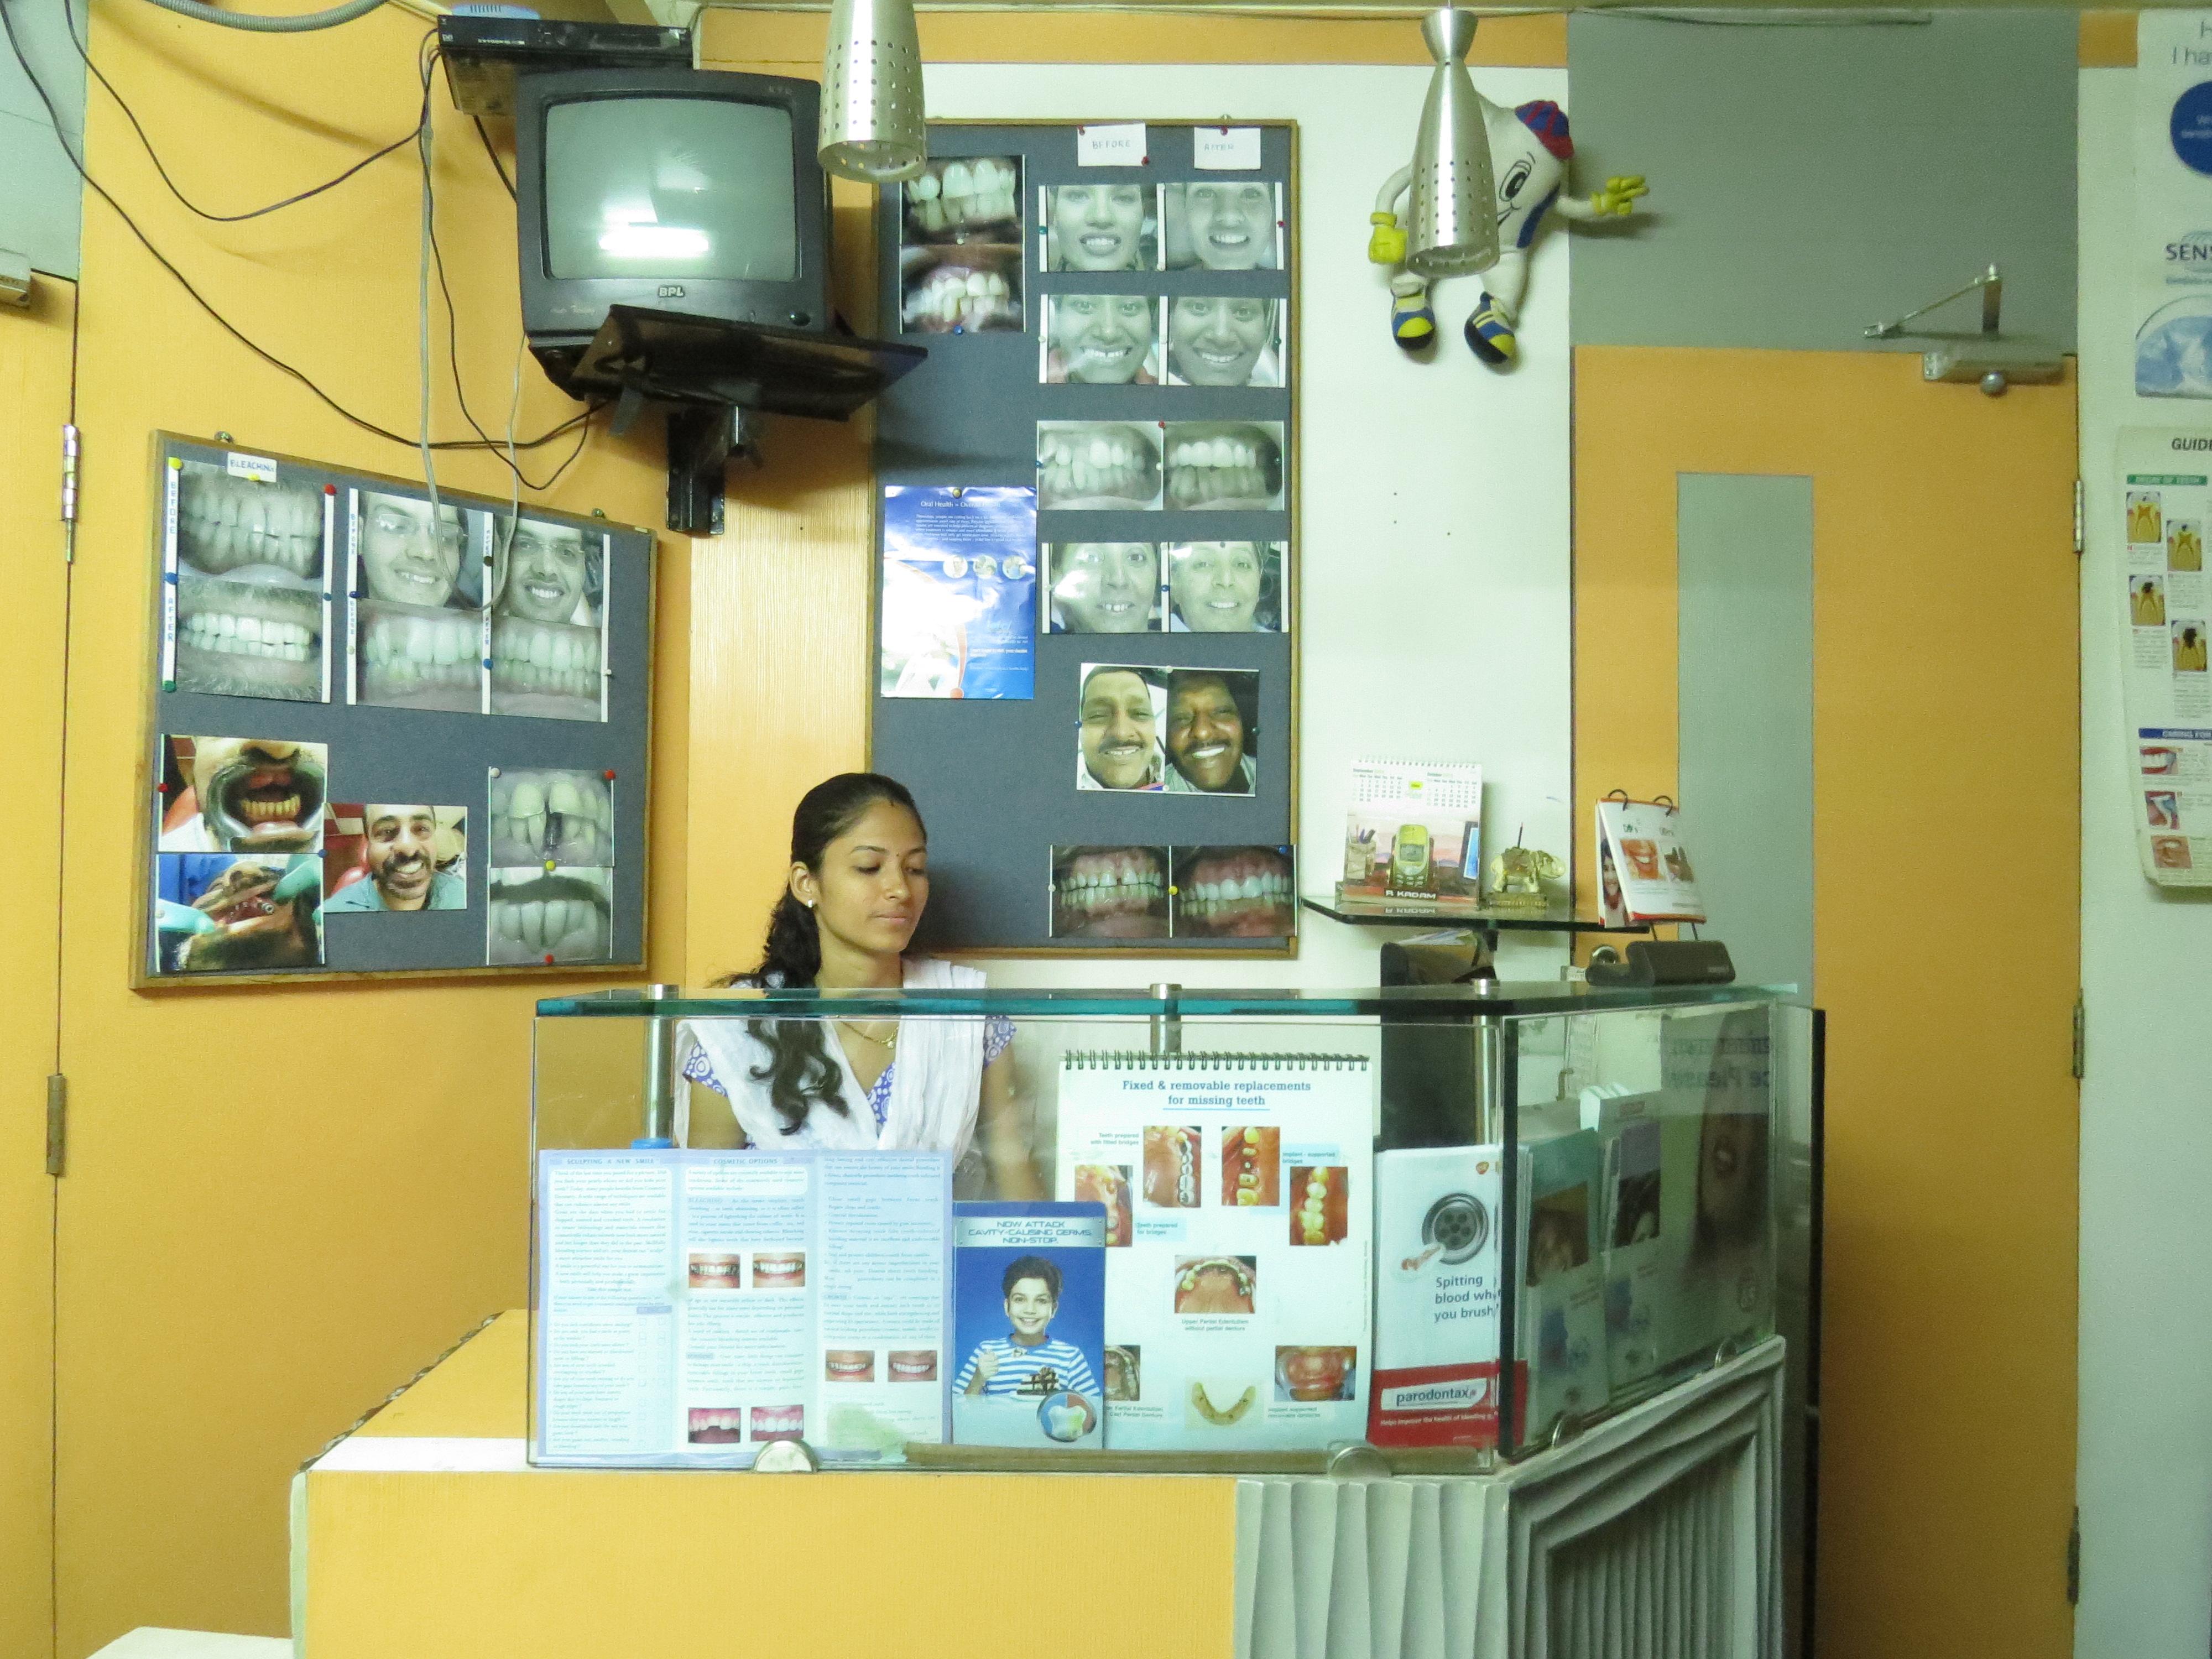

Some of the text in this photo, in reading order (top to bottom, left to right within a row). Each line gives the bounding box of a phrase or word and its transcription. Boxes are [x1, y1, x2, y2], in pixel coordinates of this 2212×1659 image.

[2184, 47, 2212, 65] ha
[1092, 140, 1131, 149] BEFORE
[659, 286, 684, 297] BPL
[1397, 890, 1437, 900] KADAM
[1123, 1081, 1311, 1093] Fixed & removable replacements
[1168, 1095, 1265, 1108] for missing teeth
[1436, 1275, 1483, 1290] Spitting
[1436, 1290, 1469, 1304] blood
[1434, 1311, 1457, 1323] you
[1396, 1387, 1470, 1406] parodontax
